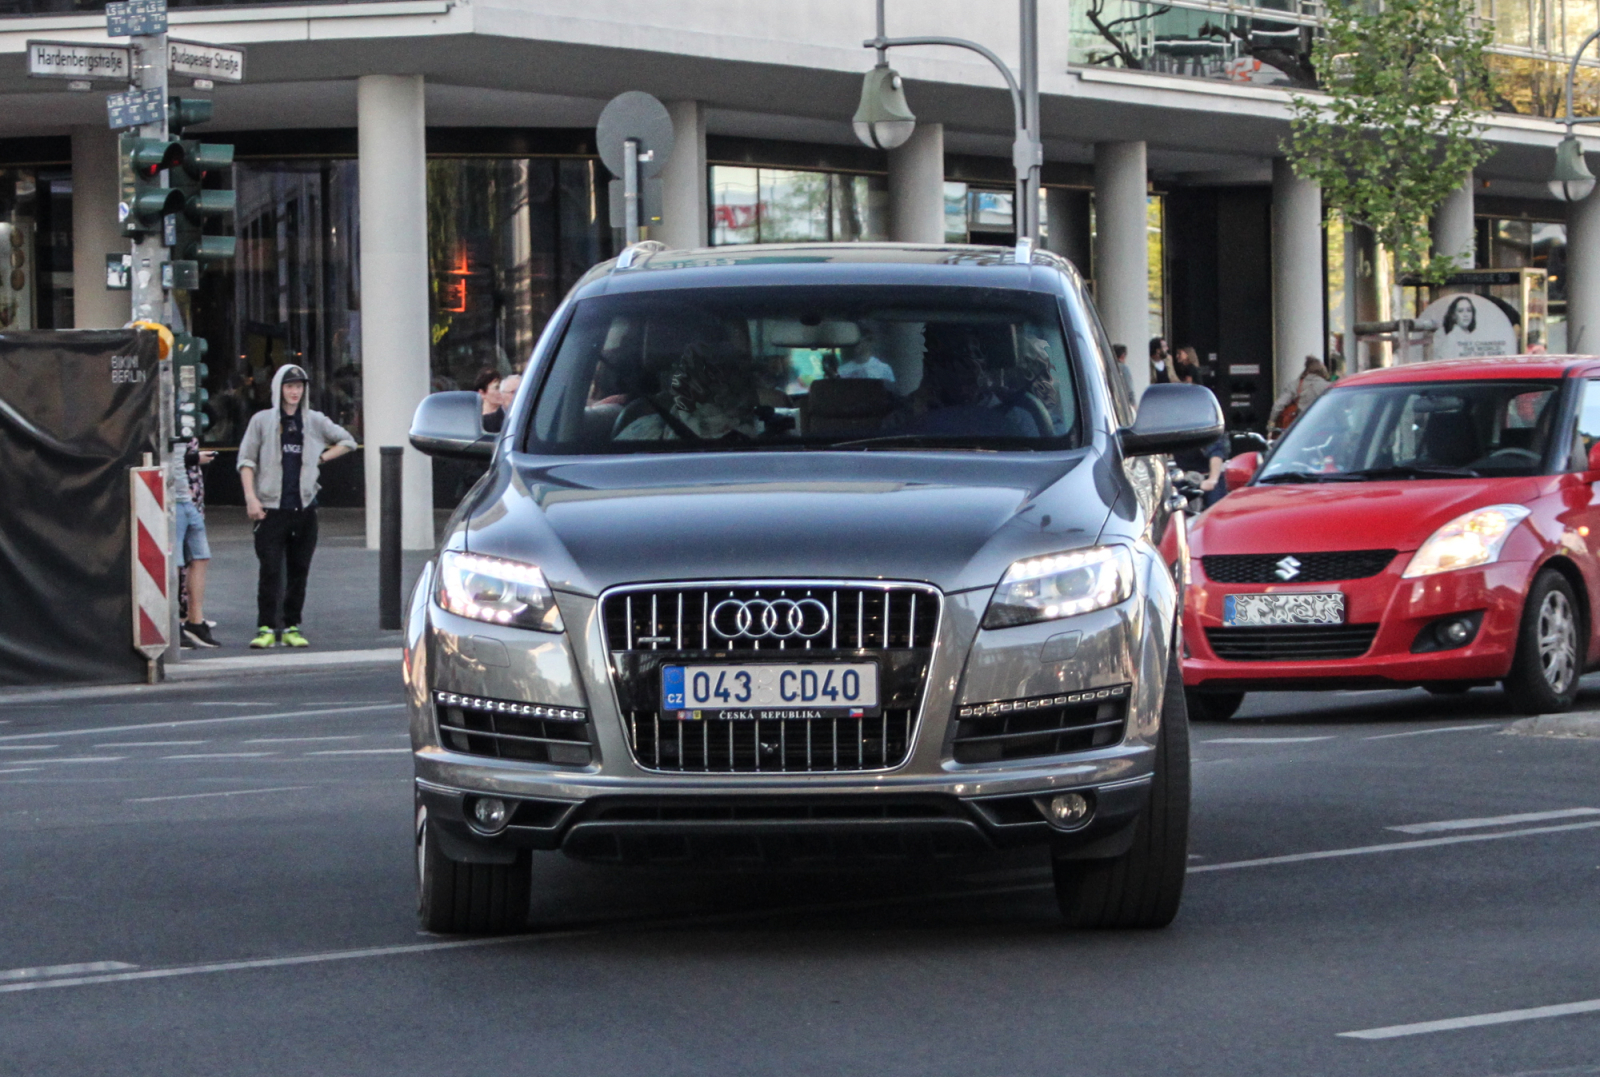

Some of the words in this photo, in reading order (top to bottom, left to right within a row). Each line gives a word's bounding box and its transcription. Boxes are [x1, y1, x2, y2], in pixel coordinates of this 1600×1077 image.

[37, 48, 122, 72] Hardenbergstraße
[171, 46, 213, 68] Budapester
[214, 53, 239, 74] Straße
[111, 355, 139, 369] BIKINI
[111, 370, 147, 383] BERLIN
[692, 670, 752, 704] 043
[779, 668, 860, 702] CD40
[667, 693, 683, 703] CZ
[719, 709, 754, 720] ČESKÁ
[760, 709, 822, 719] REPUBLIKA
